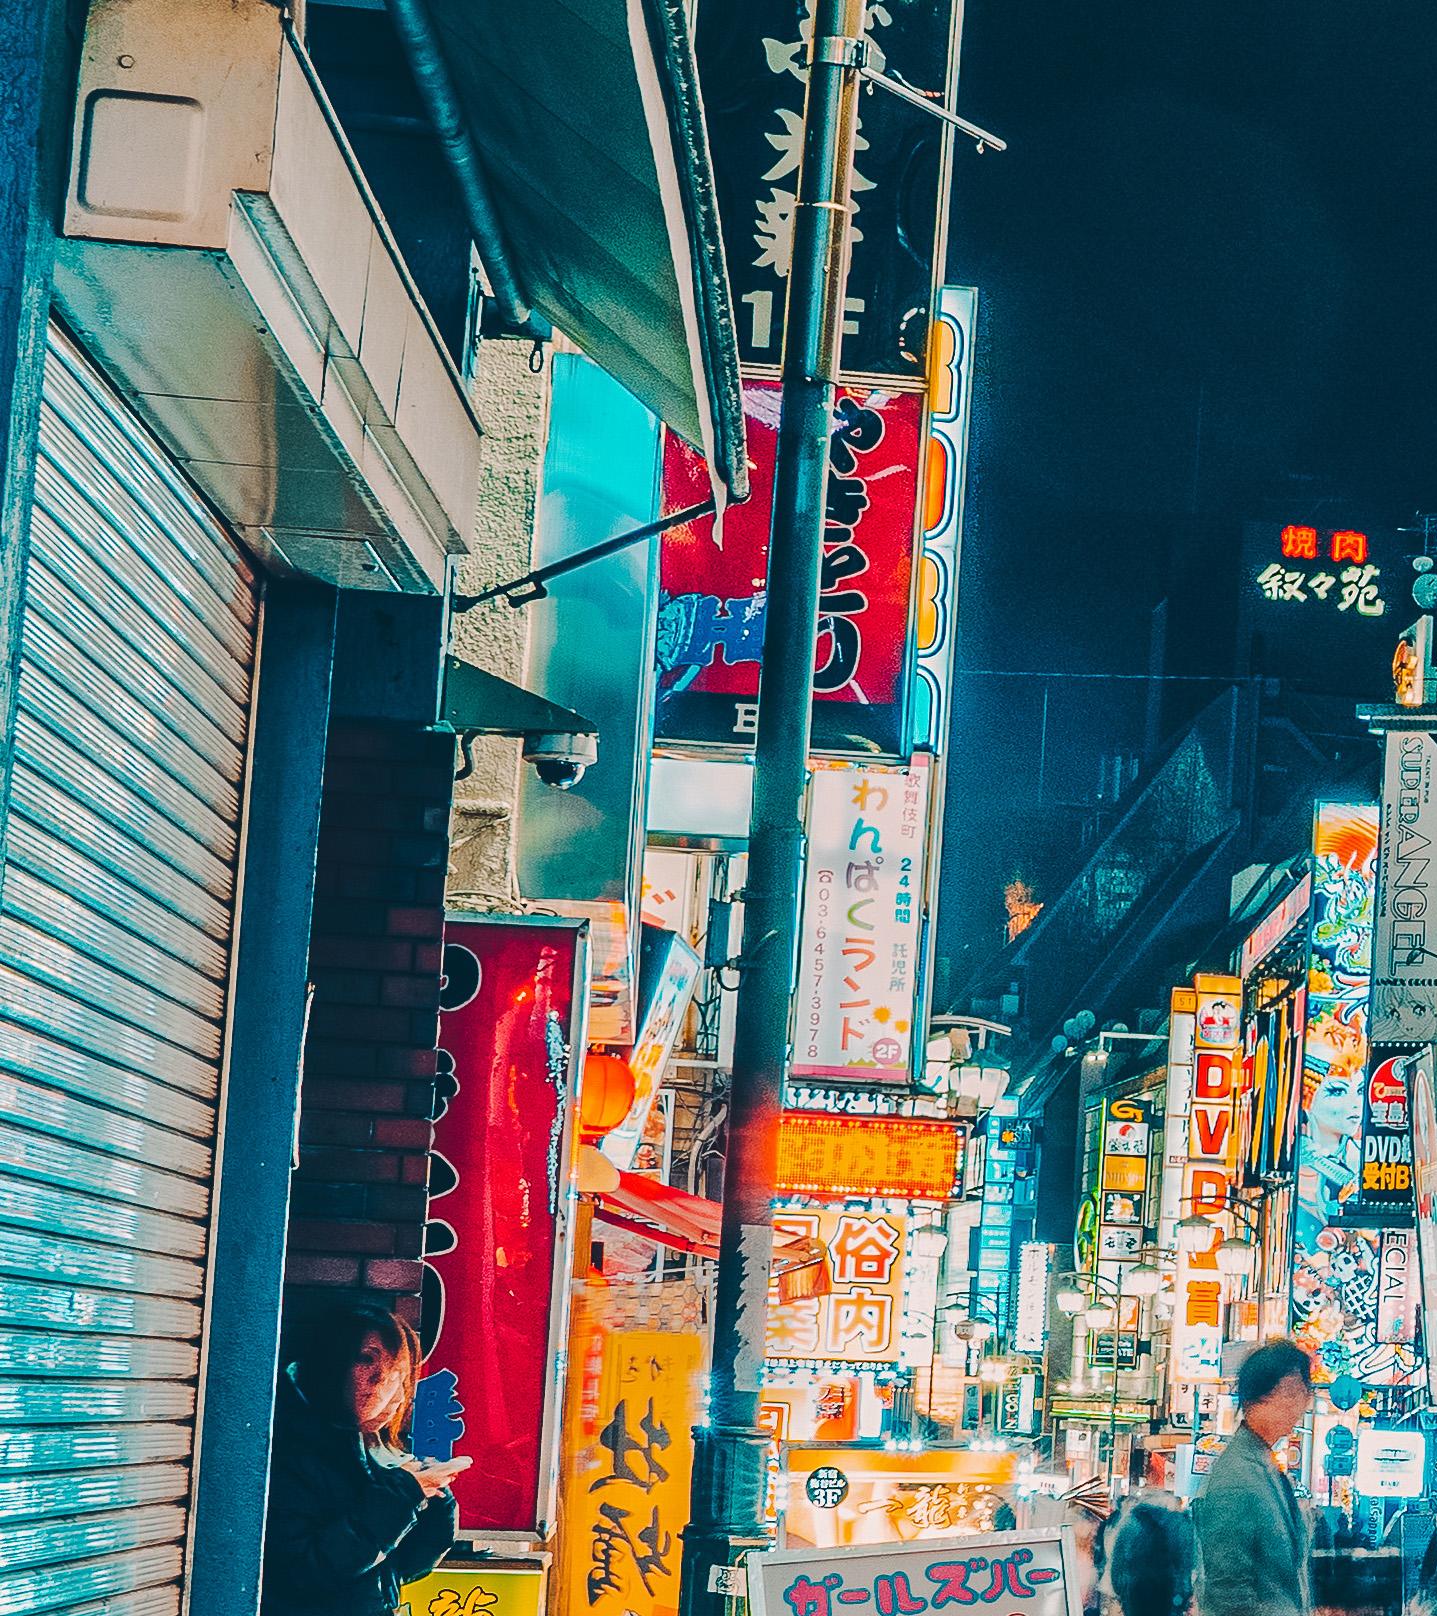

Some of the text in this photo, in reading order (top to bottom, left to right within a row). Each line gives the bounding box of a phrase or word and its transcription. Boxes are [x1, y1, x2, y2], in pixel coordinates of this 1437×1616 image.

[1281, 525, 1367, 564] 焼肉
[1256, 562, 1386, 617] 叙々苑
[839, 778, 889, 1053] わんぱくランド
